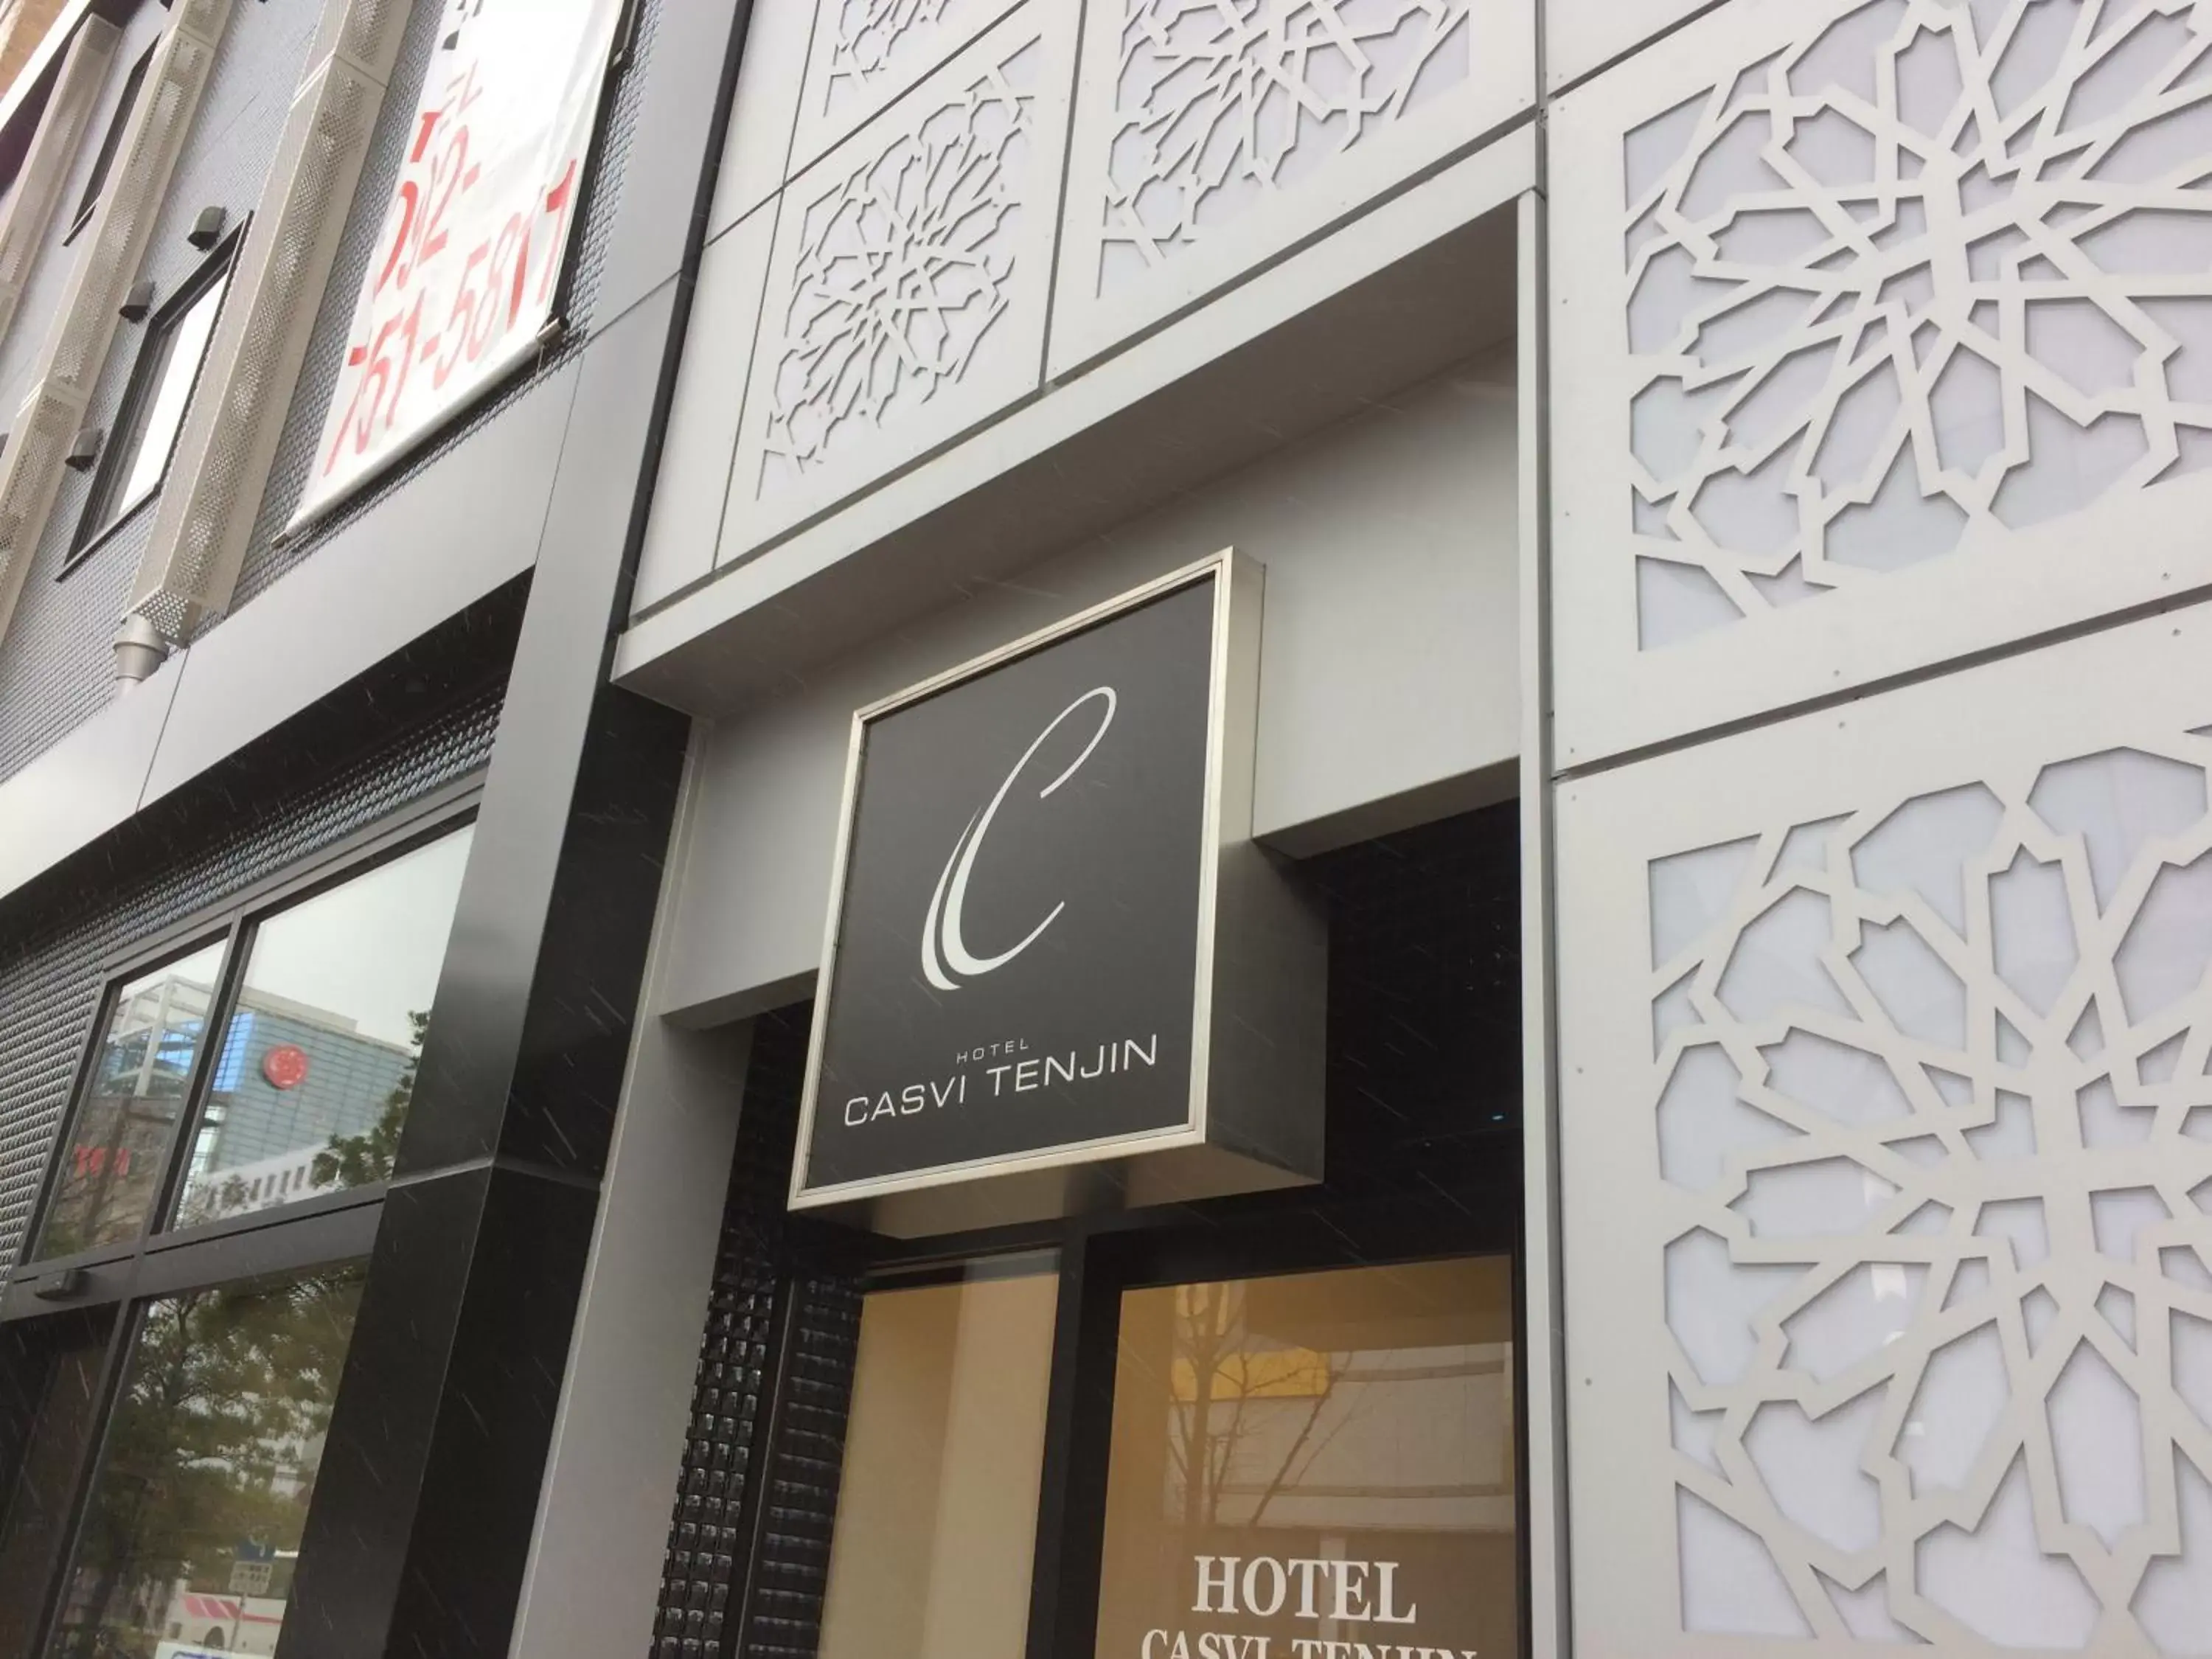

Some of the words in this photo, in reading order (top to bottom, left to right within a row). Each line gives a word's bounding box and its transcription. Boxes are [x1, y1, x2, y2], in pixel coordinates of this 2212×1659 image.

[844, 1074, 967, 1127] CASVI
[986, 1034, 1158, 1097] TENJIN
[956, 1037, 1029, 1065] HOTEL
[1190, 1555, 1417, 1624] HOTEL
